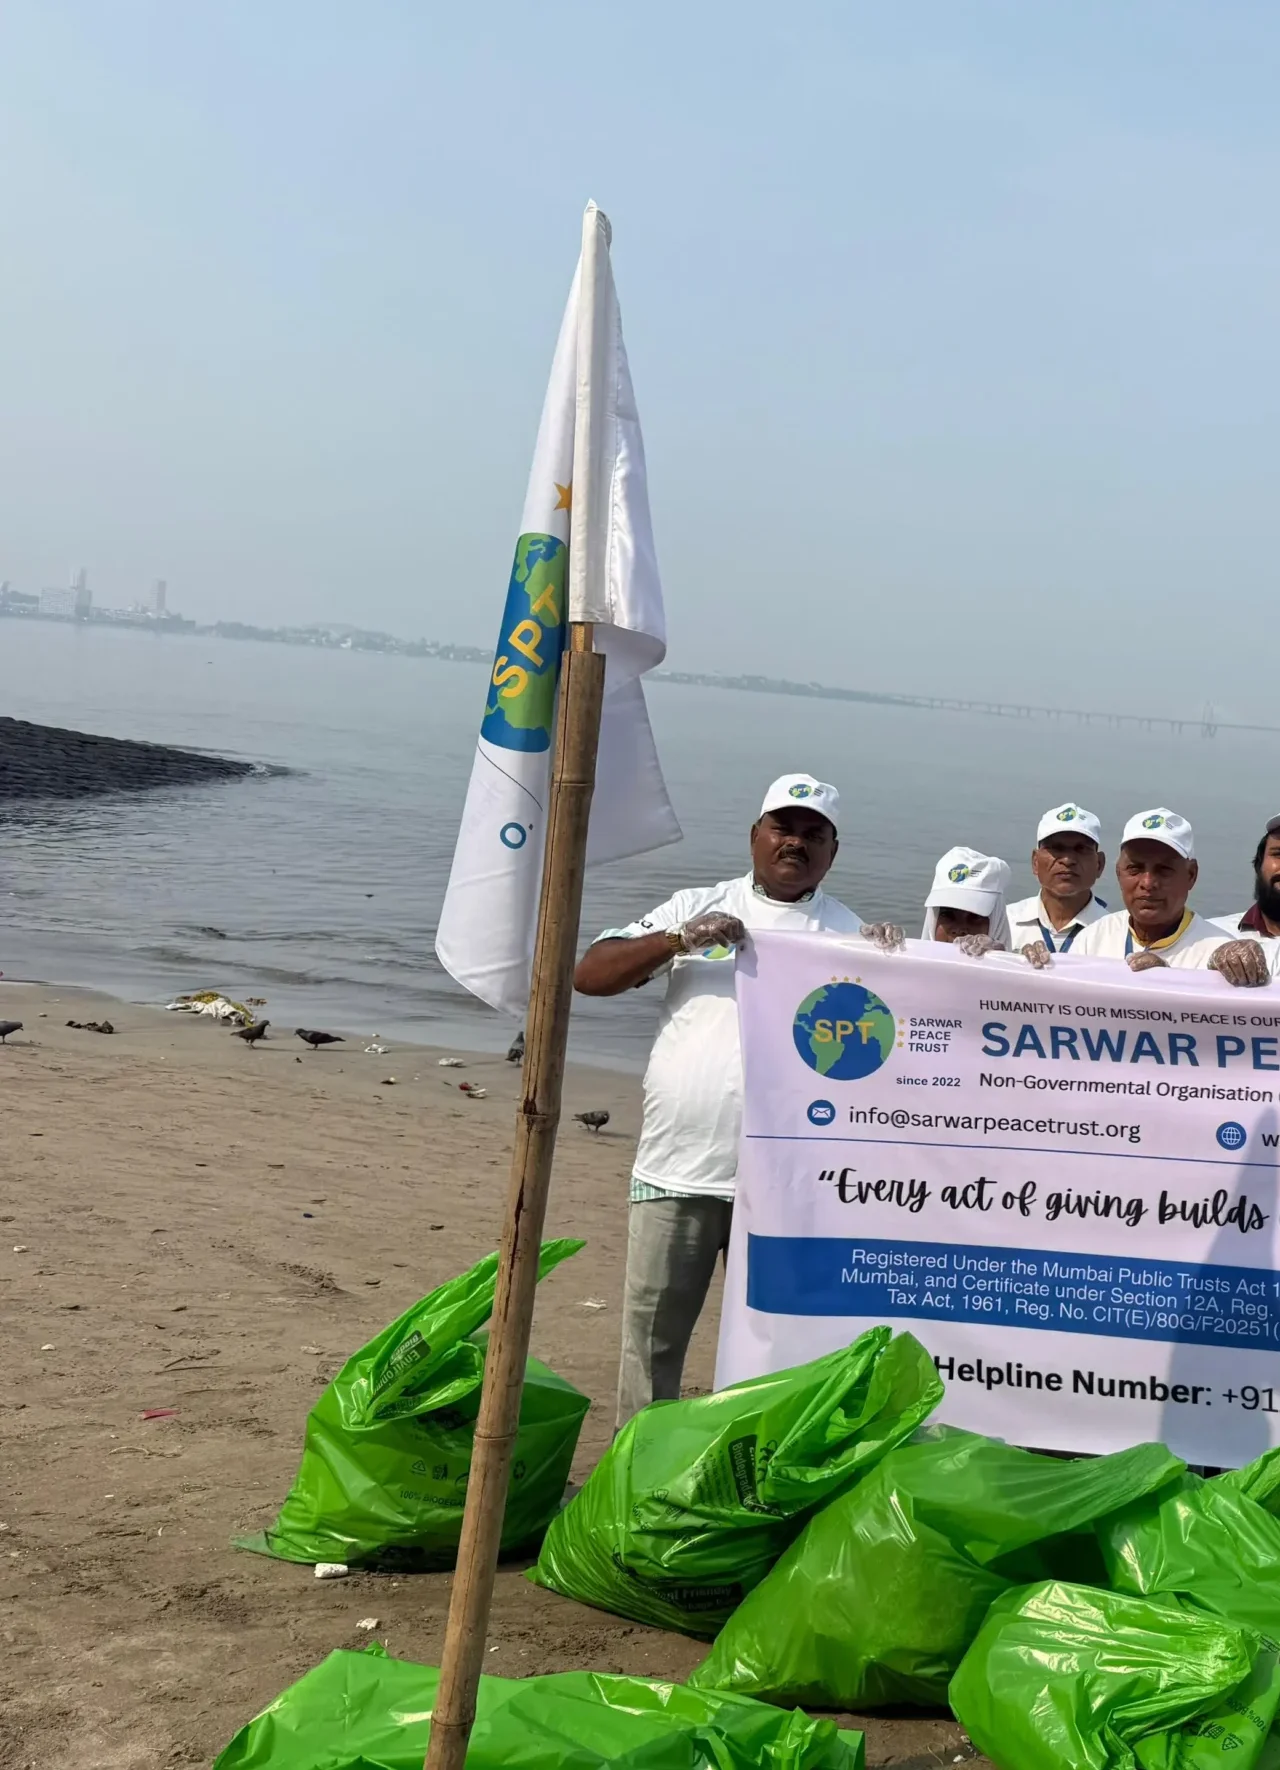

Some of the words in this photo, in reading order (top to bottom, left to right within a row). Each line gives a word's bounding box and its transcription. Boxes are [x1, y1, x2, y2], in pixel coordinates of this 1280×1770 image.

[492, 583, 560, 697] SPT
[910, 1018, 962, 1028] SARWAR
[980, 1000, 1054, 1014] HUMANITY
[1059, 1005, 1071, 1015] IS
[1075, 1006, 1106, 1017] OUR
[1110, 1008, 1177, 1023] MISSION,
[1181, 1012, 1228, 1026] PEACE
[1233, 1014, 1246, 1026] IS
[813, 1019, 874, 1045] SPT
[908, 1043, 948, 1052] TRUST
[910, 1030, 951, 1040] PEACE
[981, 1021, 1200, 1067] SARWAR
[897, 1076, 928, 1085] since
[932, 1077, 960, 1087] 2022
[980, 1073, 1151, 1095] Non-Governmental
[1157, 1082, 1272, 1102] Organisation
[850, 1106, 1141, 1143] info@sarwarpeacetrust.org
[941, 1177, 997, 1211] act
[1002, 1181, 1036, 1216] of
[1046, 1188, 1148, 1227] giving
[1159, 1189, 1270, 1233] builds
[852, 1249, 947, 1268] Registered
[954, 1255, 1006, 1272] Under
[1011, 1259, 1037, 1275] the
[1043, 1262, 1112, 1282] Mumbai
[1119, 1268, 1172, 1287] Public
[1177, 1273, 1229, 1292] Trusts
[1236, 1279, 1265, 1296] Act
[841, 1268, 918, 1288] Mumbai,
[925, 1274, 956, 1288] and
[963, 1275, 1049, 1296] Certificate
[1056, 1285, 1105, 1301] under
[1111, 1288, 1177, 1308] Section
[1185, 1295, 1223, 1313] 12A,
[1232, 1299, 1272, 1320] Reg.
[887, 1289, 916, 1305] Tax
[922, 1292, 954, 1310] Act,
[963, 1295, 1008, 1314] 1961,
[1016, 1299, 1053, 1320] Reg.
[1060, 1303, 1087, 1319] No.
[934, 1355, 1063, 1391] Helpline
[1073, 1370, 1211, 1405] Number:
[1223, 1386, 1278, 1412] +91
